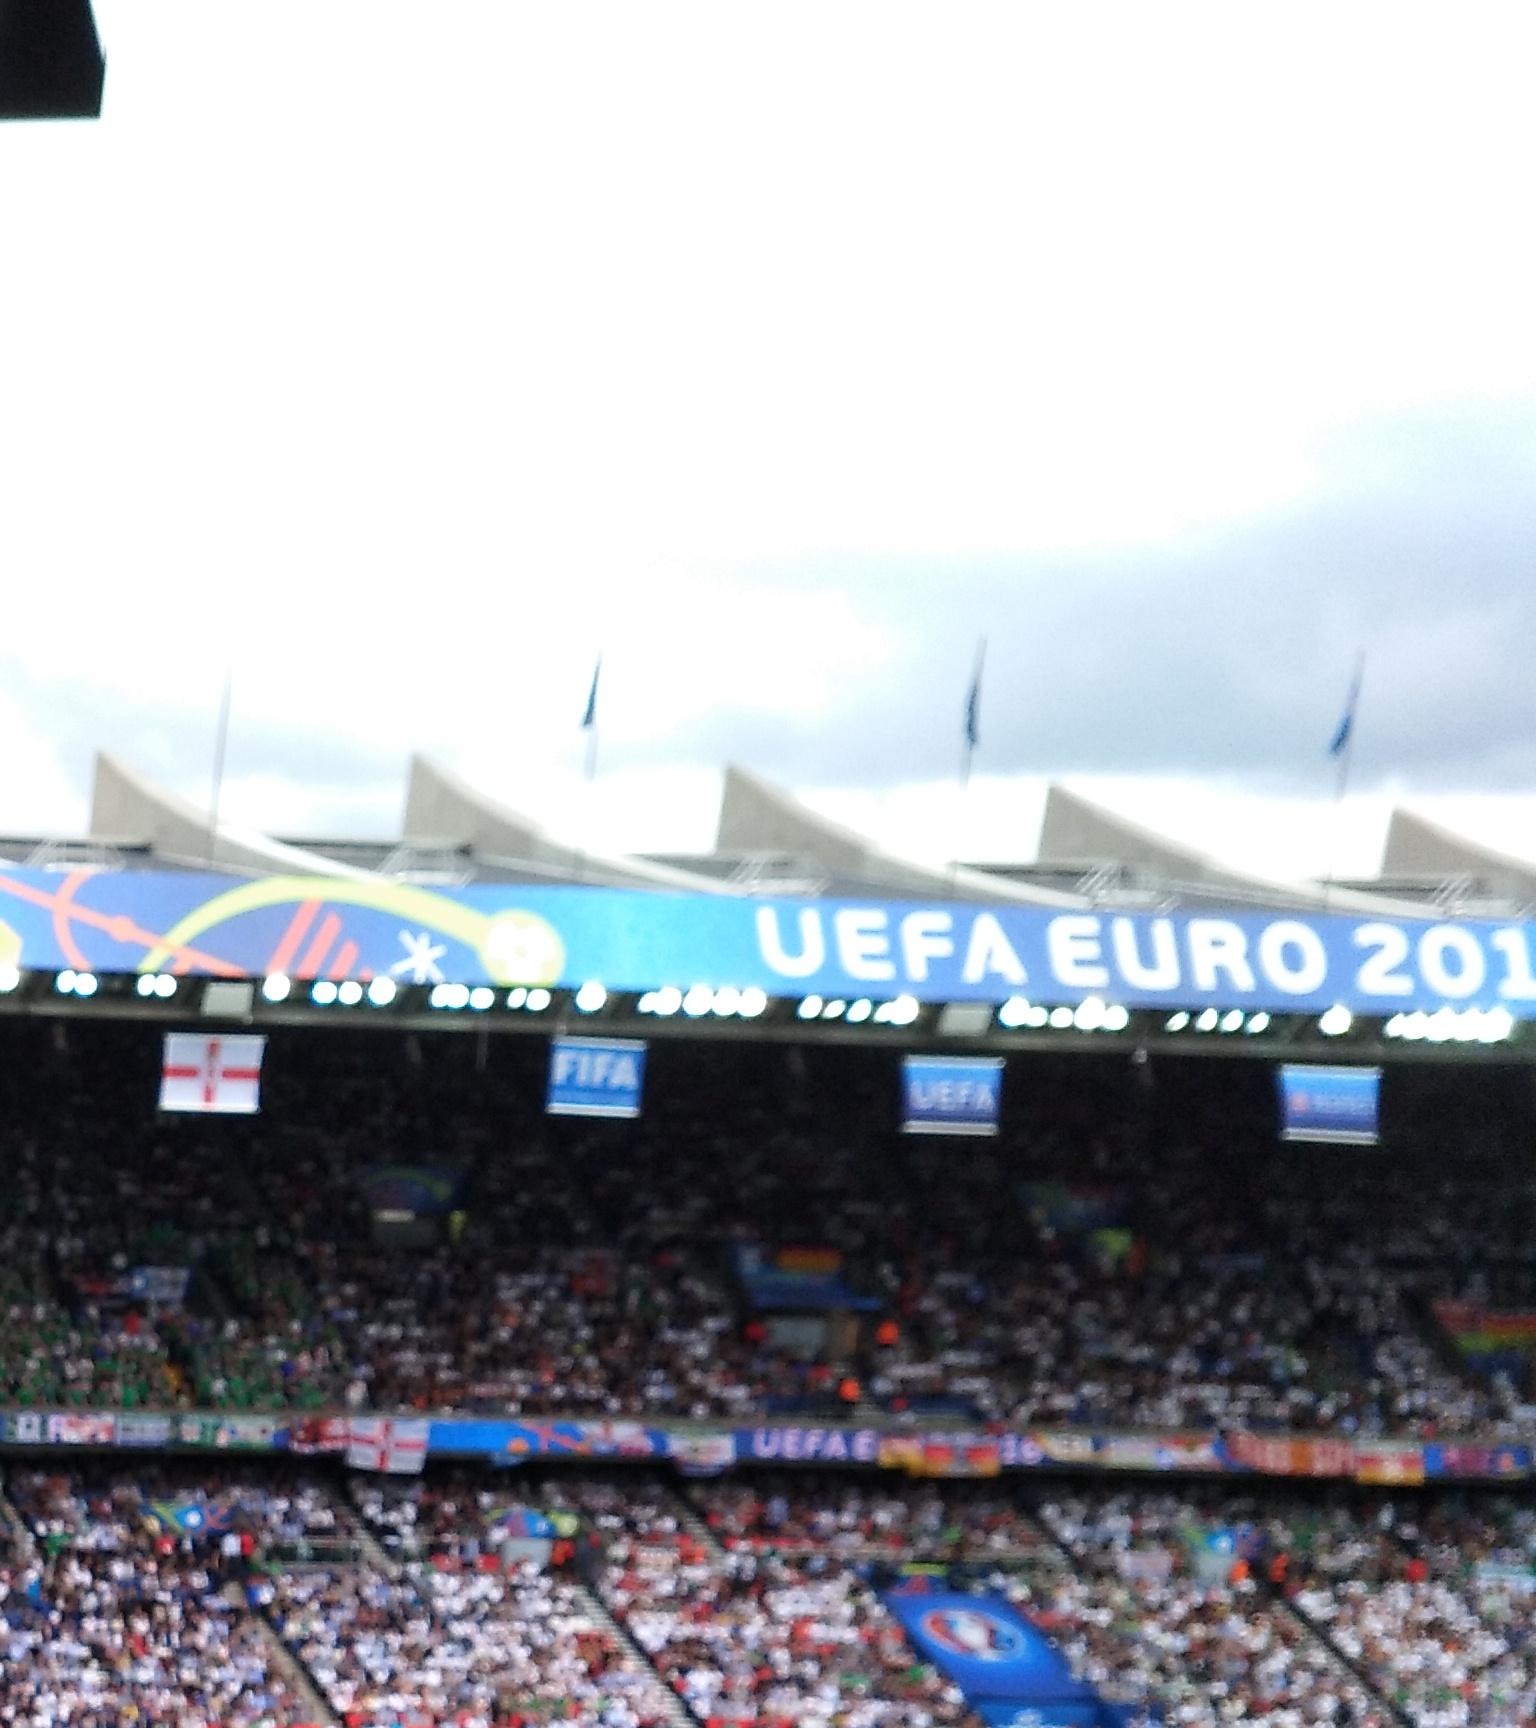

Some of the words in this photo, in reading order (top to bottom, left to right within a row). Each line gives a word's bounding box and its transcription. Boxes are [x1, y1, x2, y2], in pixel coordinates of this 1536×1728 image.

[755, 905, 1026, 986] UEFA
[1046, 914, 1327, 996] EURO
[551, 1051, 639, 1089] FIFA
[910, 1080, 994, 1112] UEFA
[753, 1427, 847, 1461] UEFA
